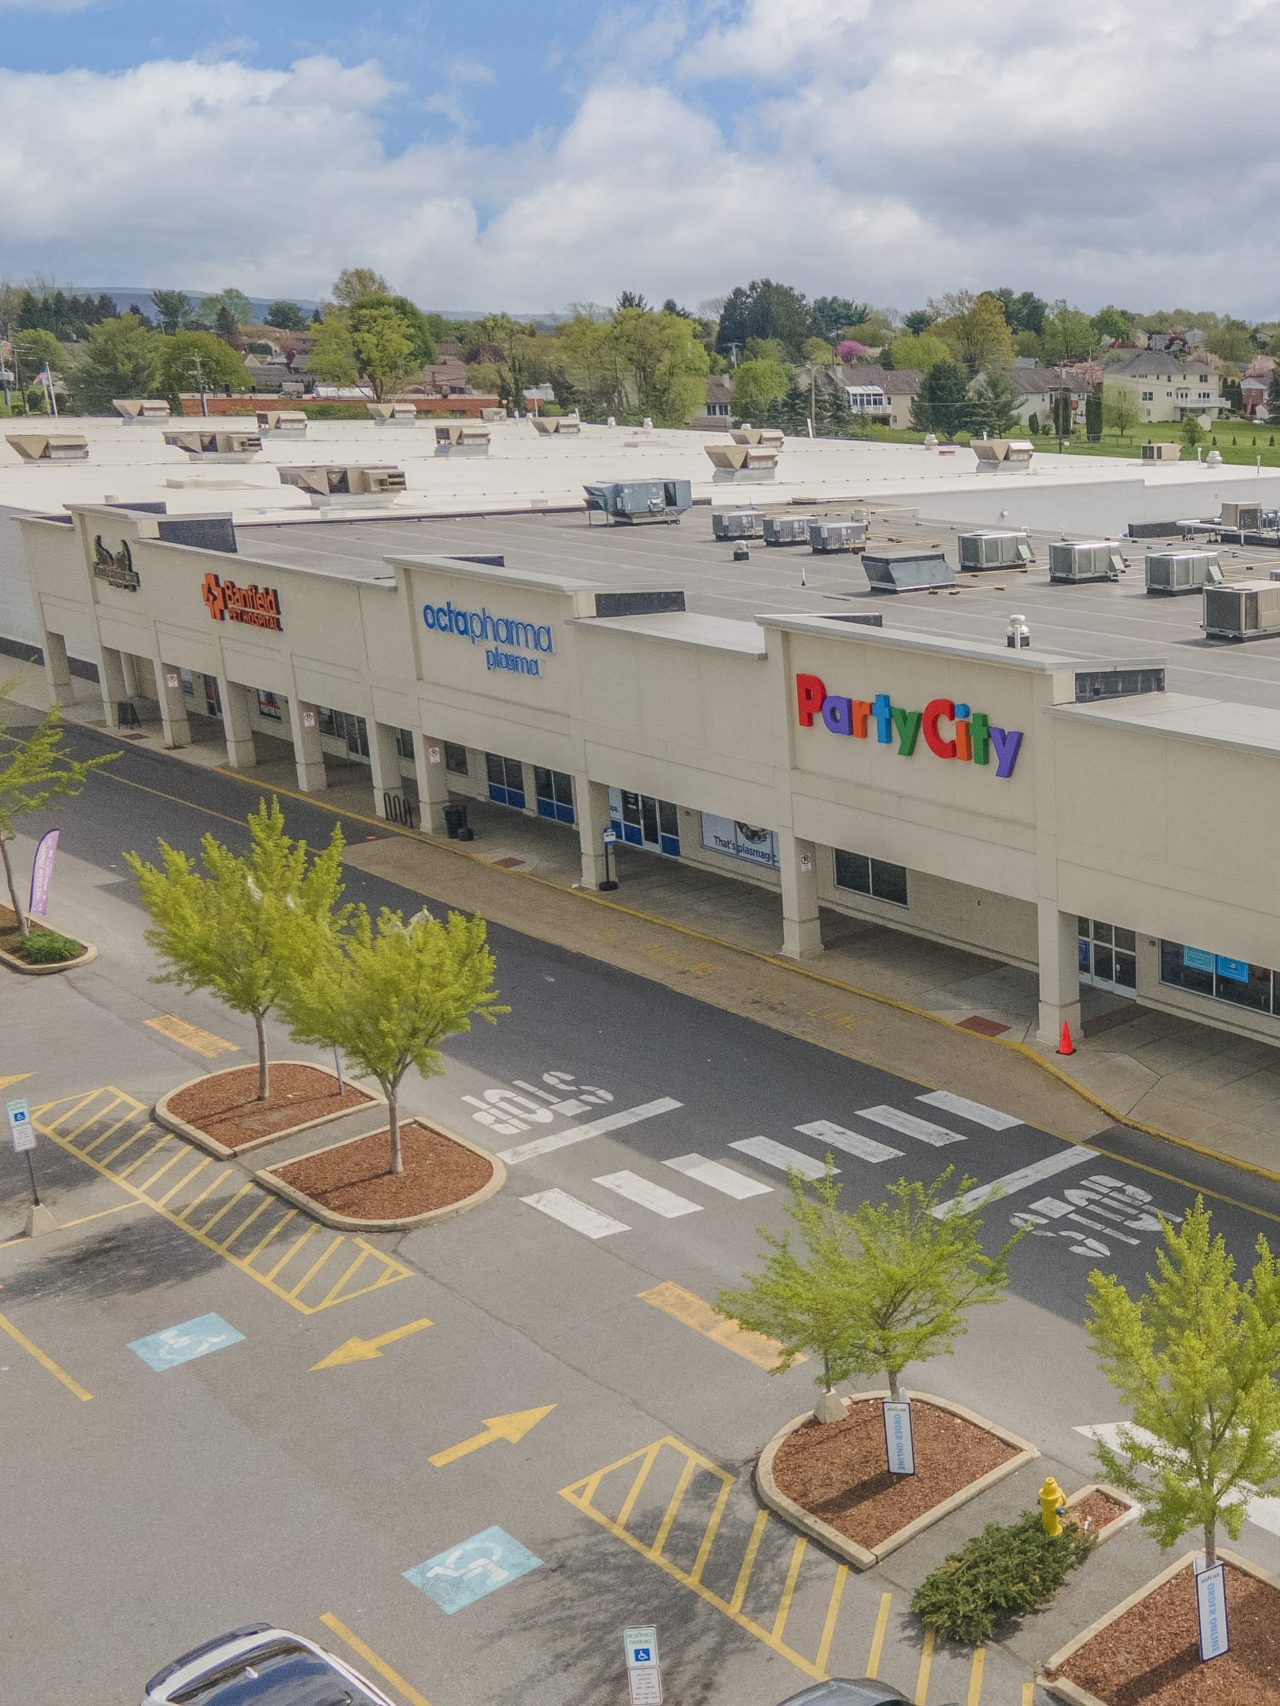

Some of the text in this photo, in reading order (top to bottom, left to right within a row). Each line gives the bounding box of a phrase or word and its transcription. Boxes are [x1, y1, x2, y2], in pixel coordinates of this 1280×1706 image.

[223, 580, 281, 615] Banfield
[228, 608, 282, 631] PET HOSPITAL
[422, 601, 553, 653] octapharma
[485, 646, 540, 677] plasma
[713, 834, 737, 851] That's
[460, 1071, 614, 1135] STOP
[1009, 1174, 1186, 1259] STOP
[894, 1414, 906, 1472] ORDER ONLINE
[1207, 1583, 1220, 1654] ORDER ONLINE
